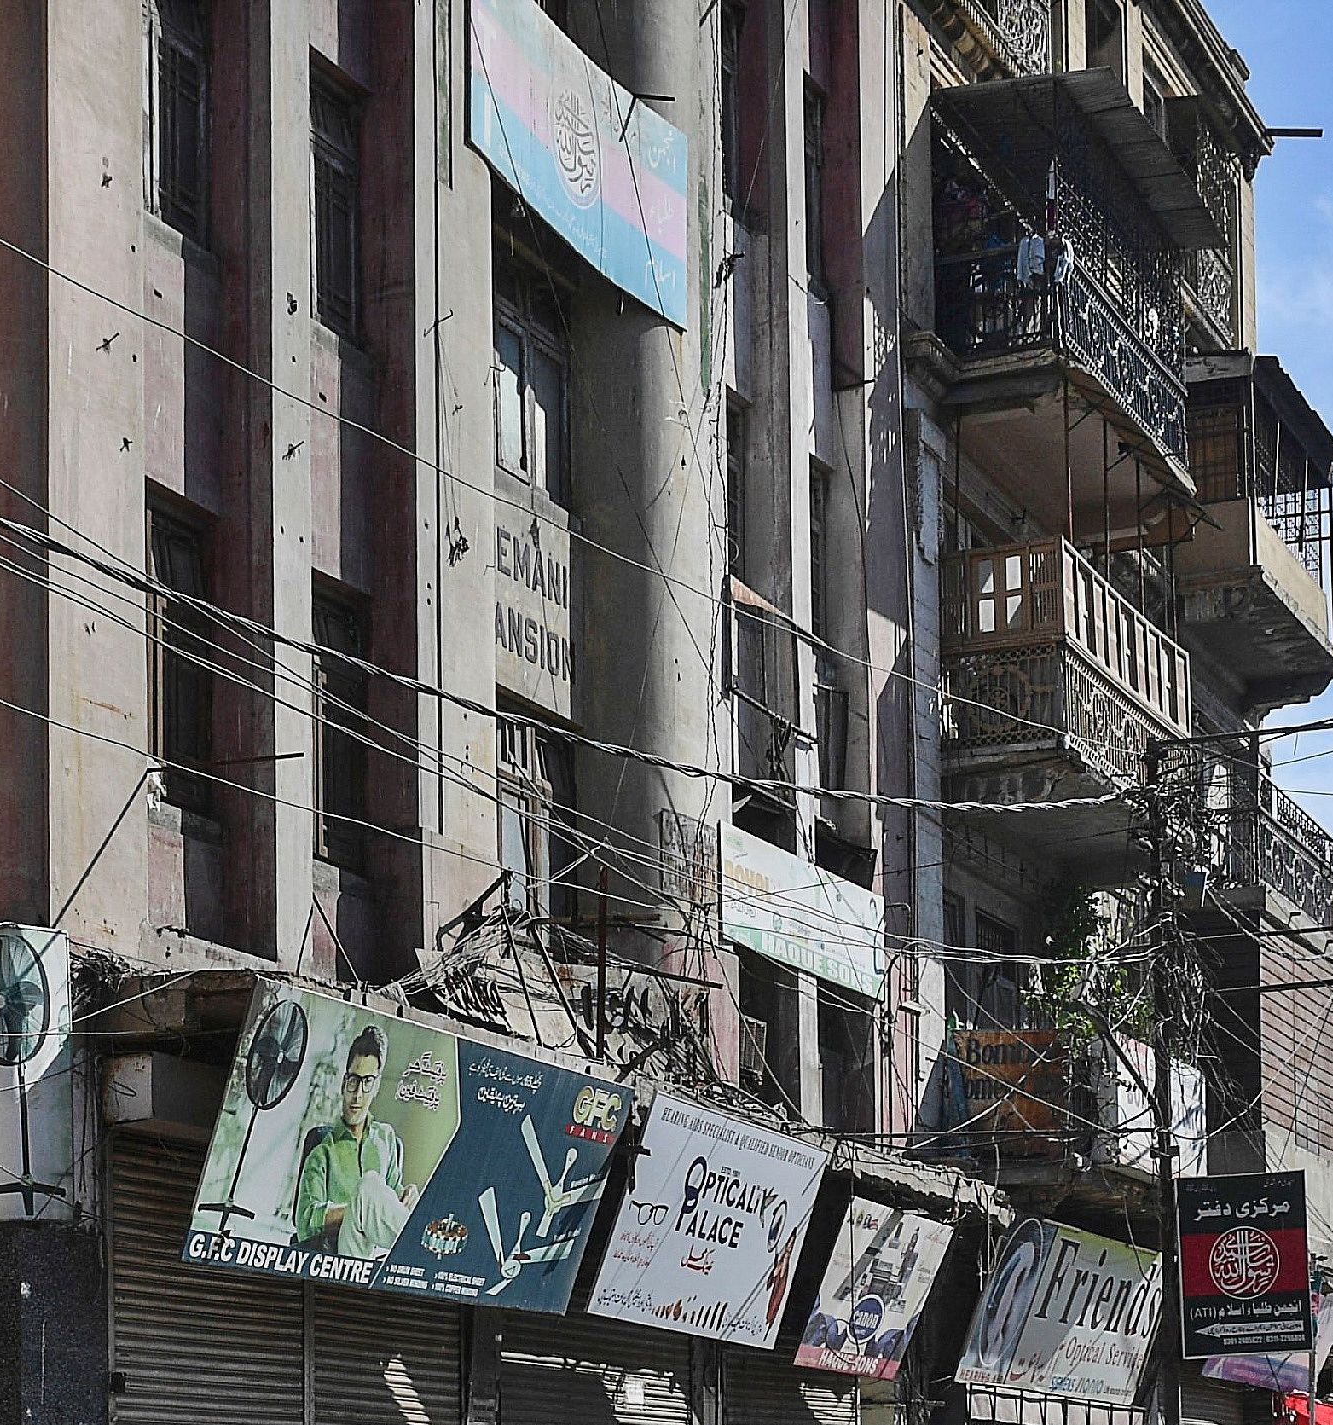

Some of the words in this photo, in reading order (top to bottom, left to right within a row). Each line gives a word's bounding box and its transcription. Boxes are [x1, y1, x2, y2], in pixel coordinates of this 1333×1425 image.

[570, 1125, 609, 1143] FANS
[675, 1200, 745, 1249] PALACE
[1192, 1199, 1232, 1222] دفتر
[235, 1241, 309, 1274] DISPLAY
[308, 1256, 375, 1284] CENTRE
[1034, 1238, 1163, 1339] Friends
[1189, 1306, 1217, 1320] (ATI)
[1065, 1336, 1106, 1367] Optical
